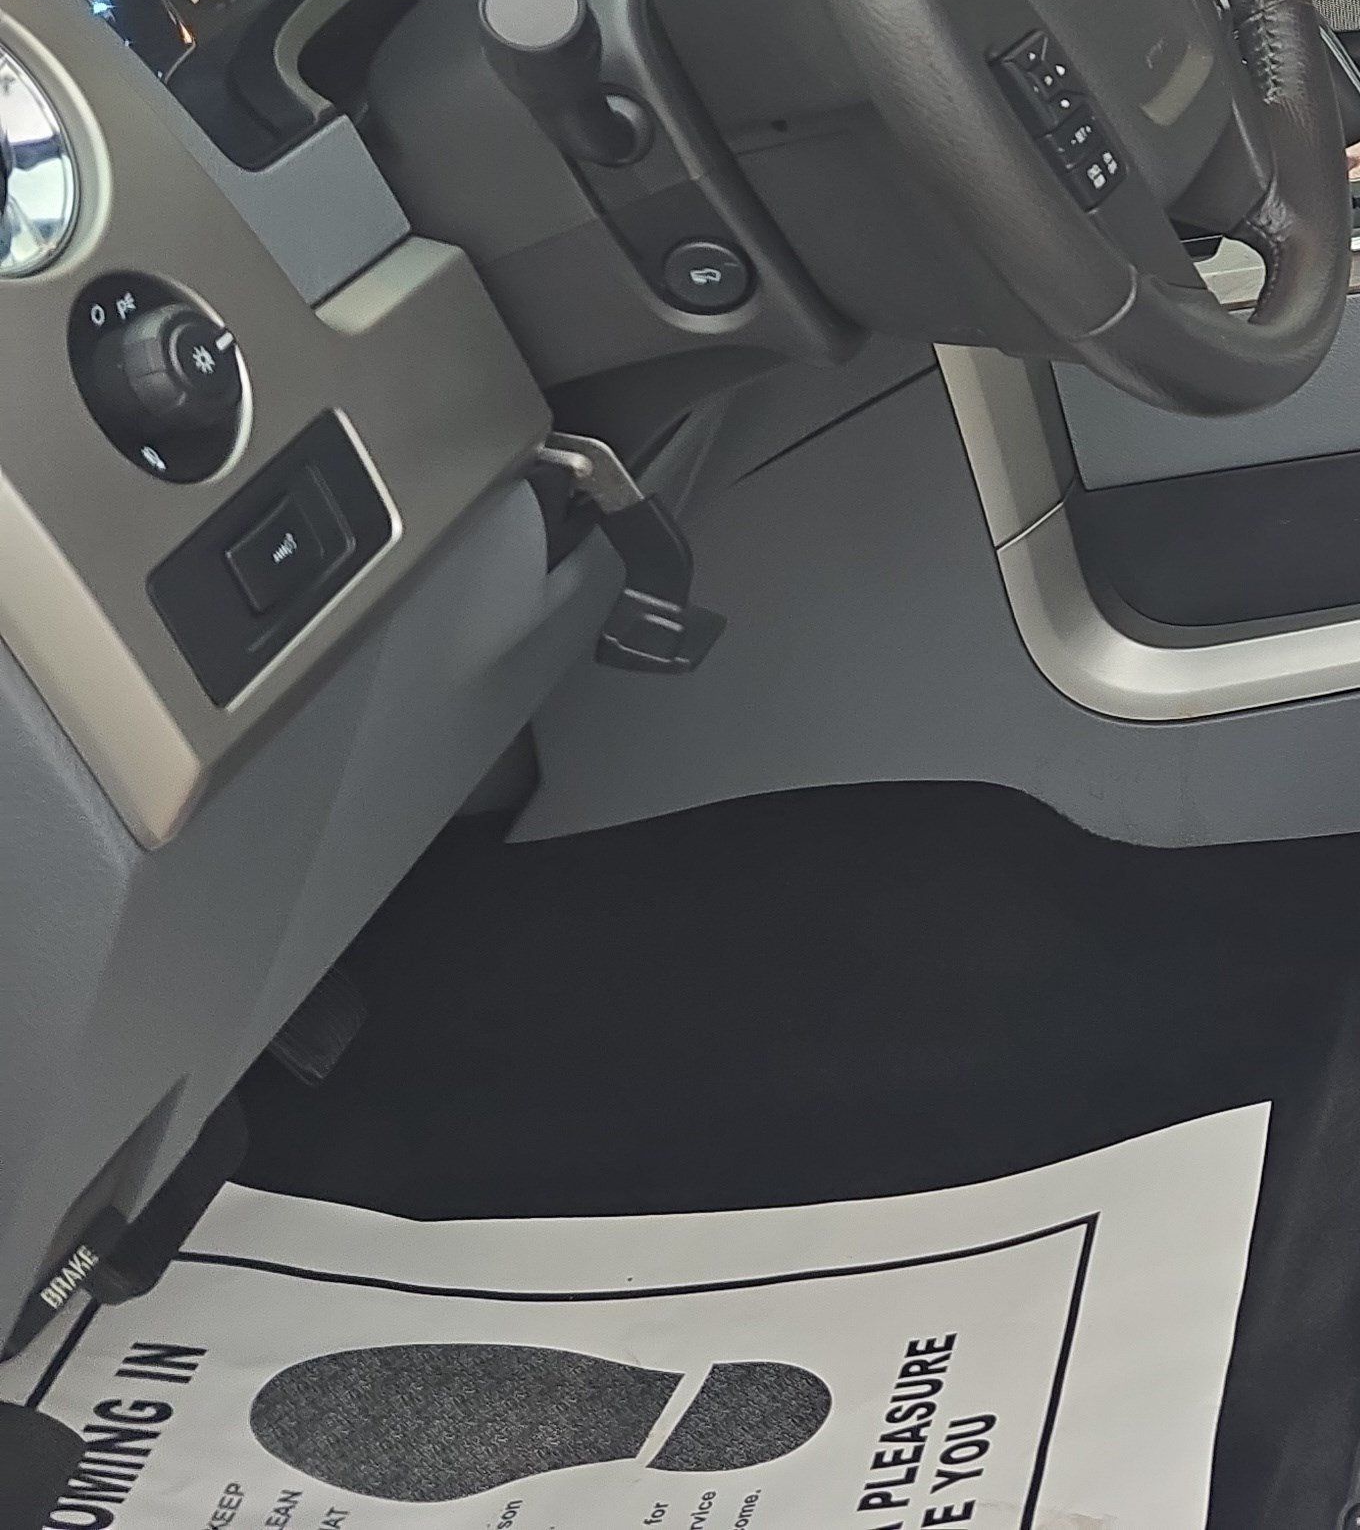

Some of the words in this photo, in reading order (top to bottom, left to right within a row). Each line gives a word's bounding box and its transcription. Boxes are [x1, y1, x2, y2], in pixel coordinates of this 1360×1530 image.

[40, 1245, 99, 1309] BRAKE
[115, 1342, 207, 1384] IN
[857, 1333, 957, 1511] PLEASURE
[930, 1414, 997, 1495] YOU
[265, 1489, 302, 1530] EAN
[319, 1507, 349, 1530] AT
[643, 1502, 669, 1525] for
[734, 1489, 762, 1530] ome.
